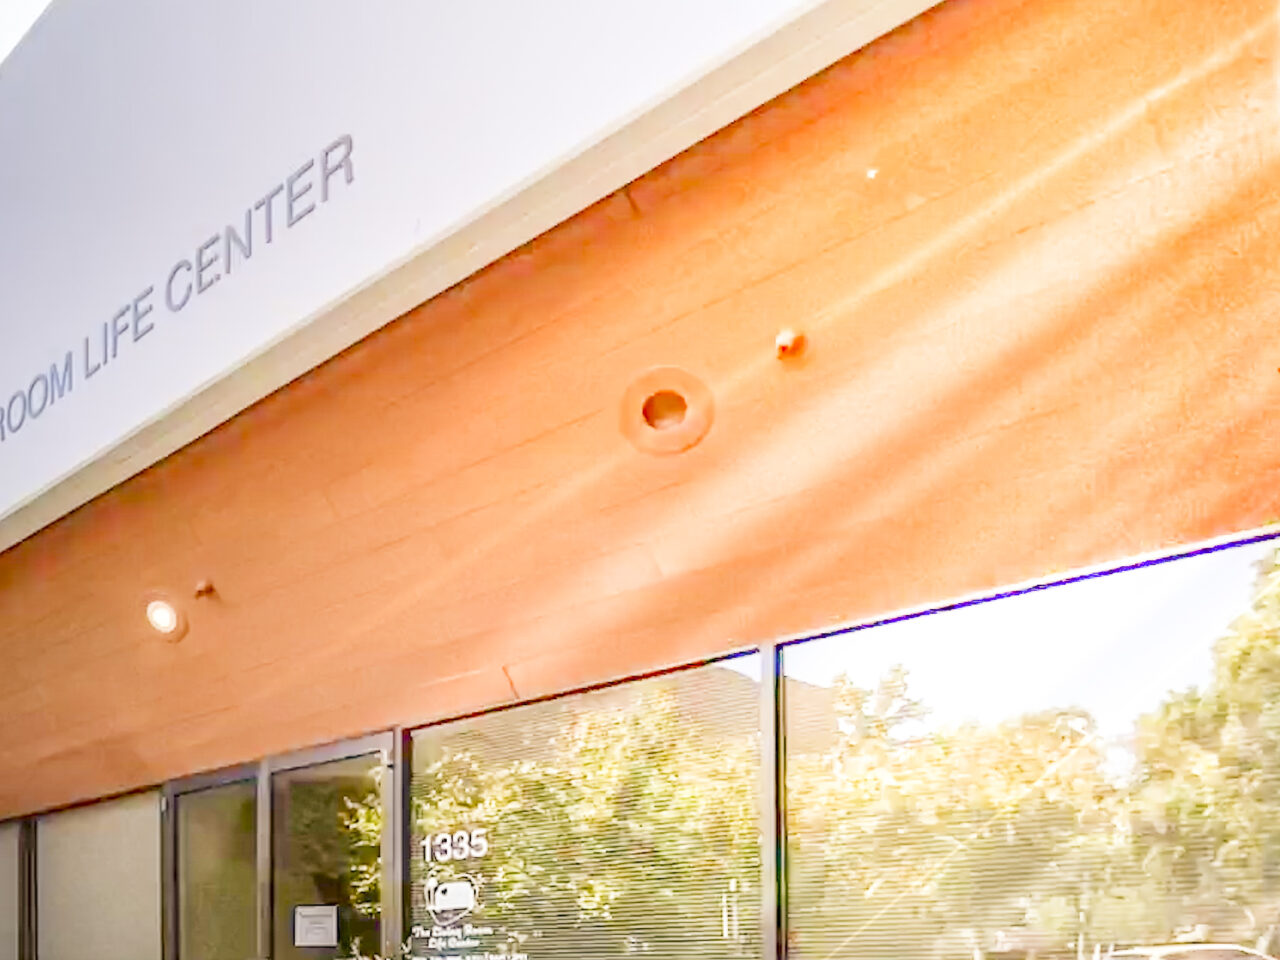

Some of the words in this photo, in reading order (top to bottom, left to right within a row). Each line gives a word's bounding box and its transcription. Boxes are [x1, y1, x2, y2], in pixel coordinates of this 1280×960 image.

[84, 285, 154, 380] LIFE
[165, 134, 354, 313] CENTER
[421, 828, 489, 862] 1335
